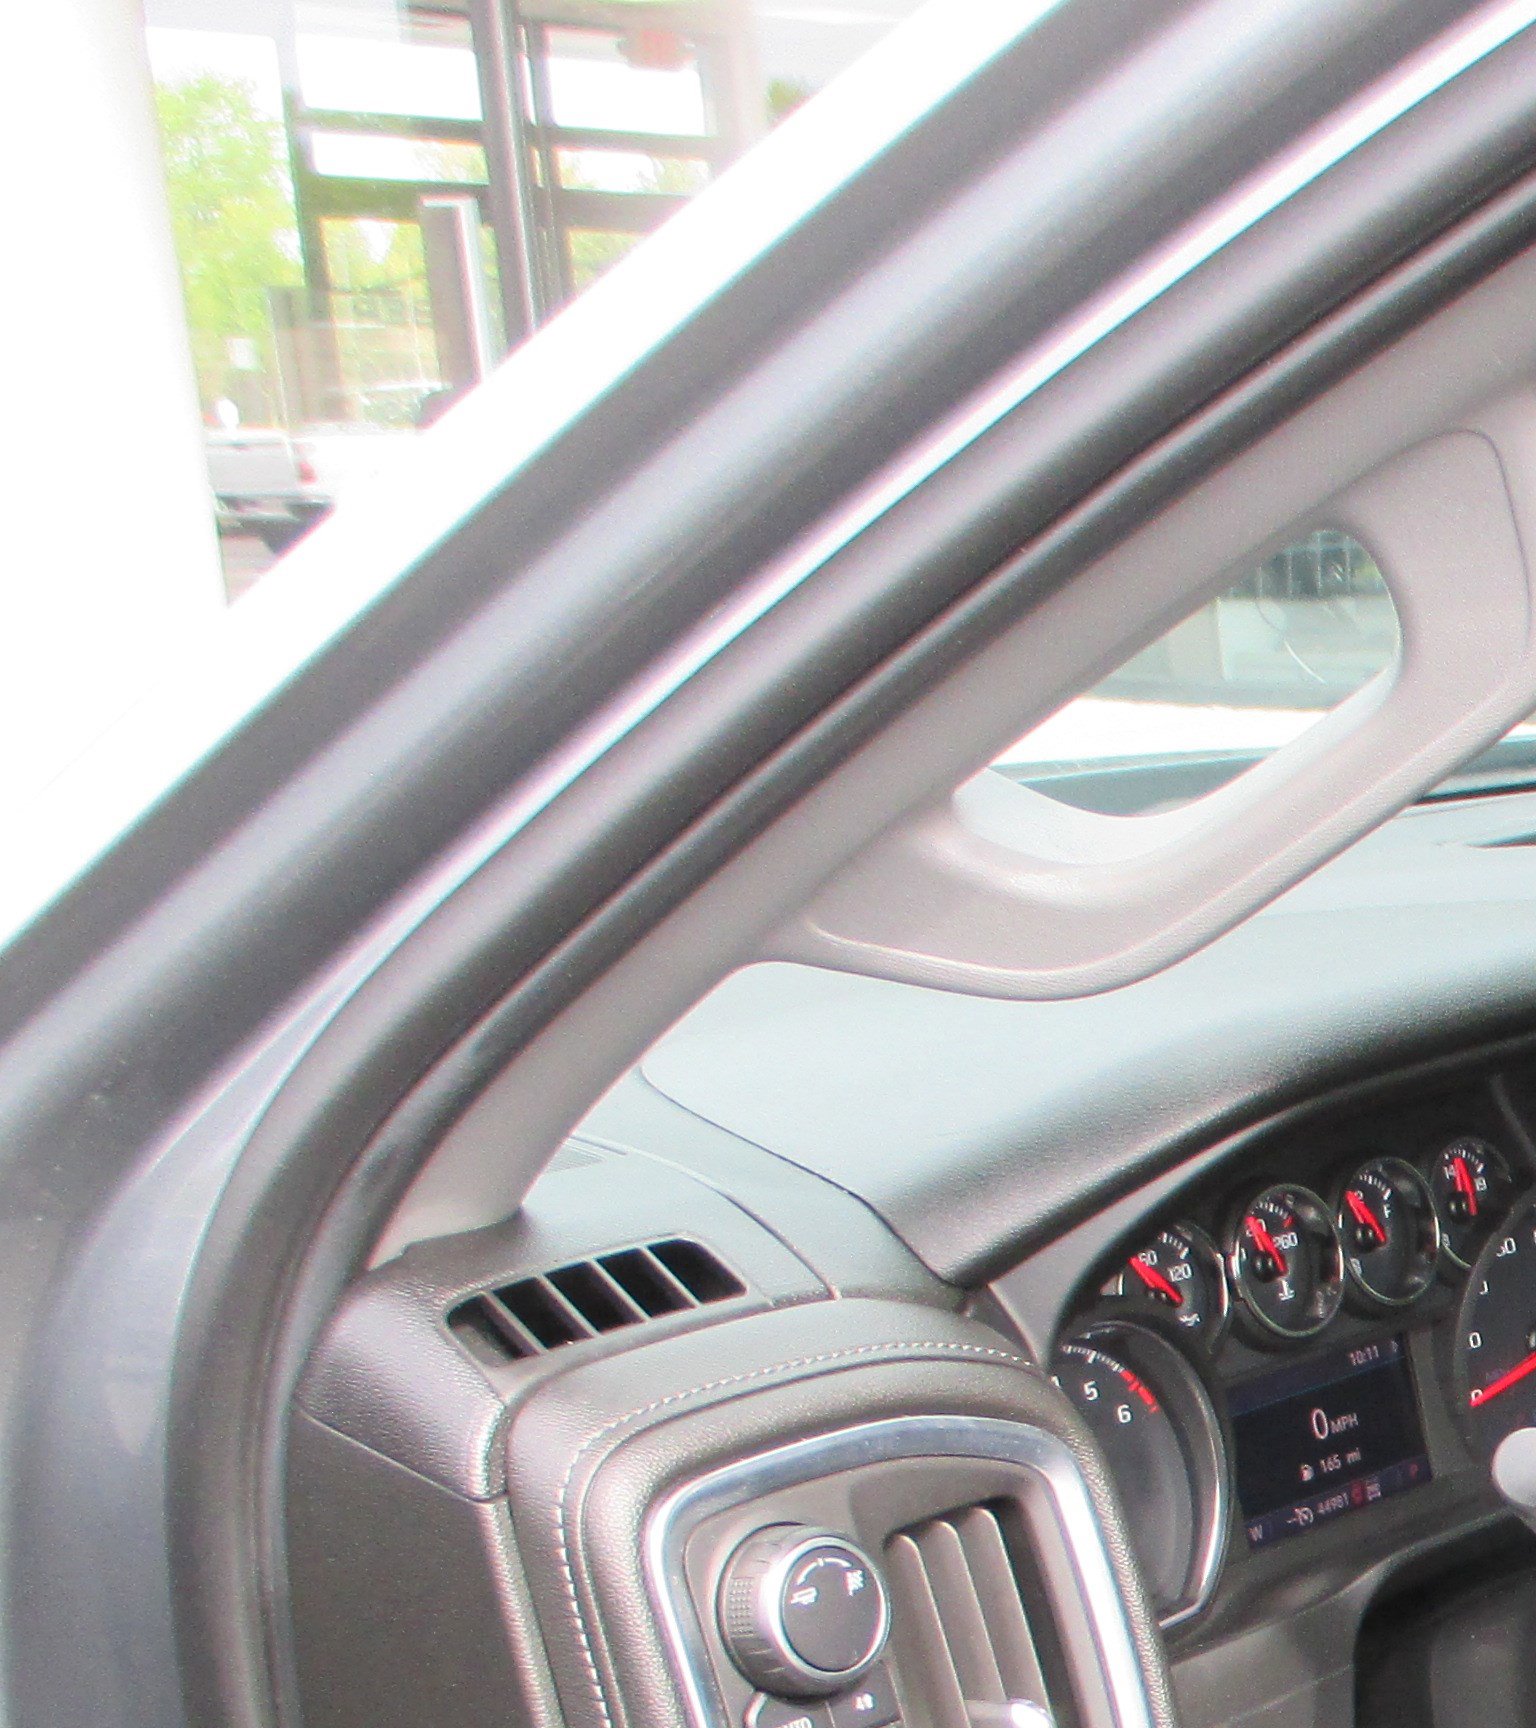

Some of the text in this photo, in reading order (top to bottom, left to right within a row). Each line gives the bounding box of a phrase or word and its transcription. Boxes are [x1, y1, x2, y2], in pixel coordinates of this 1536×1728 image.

[1168, 1262, 1192, 1282] 120
[1083, 1381, 1099, 1401] 5
[1117, 1404, 1133, 1424] 6
[1311, 1408, 1360, 1440] 0 MPH
